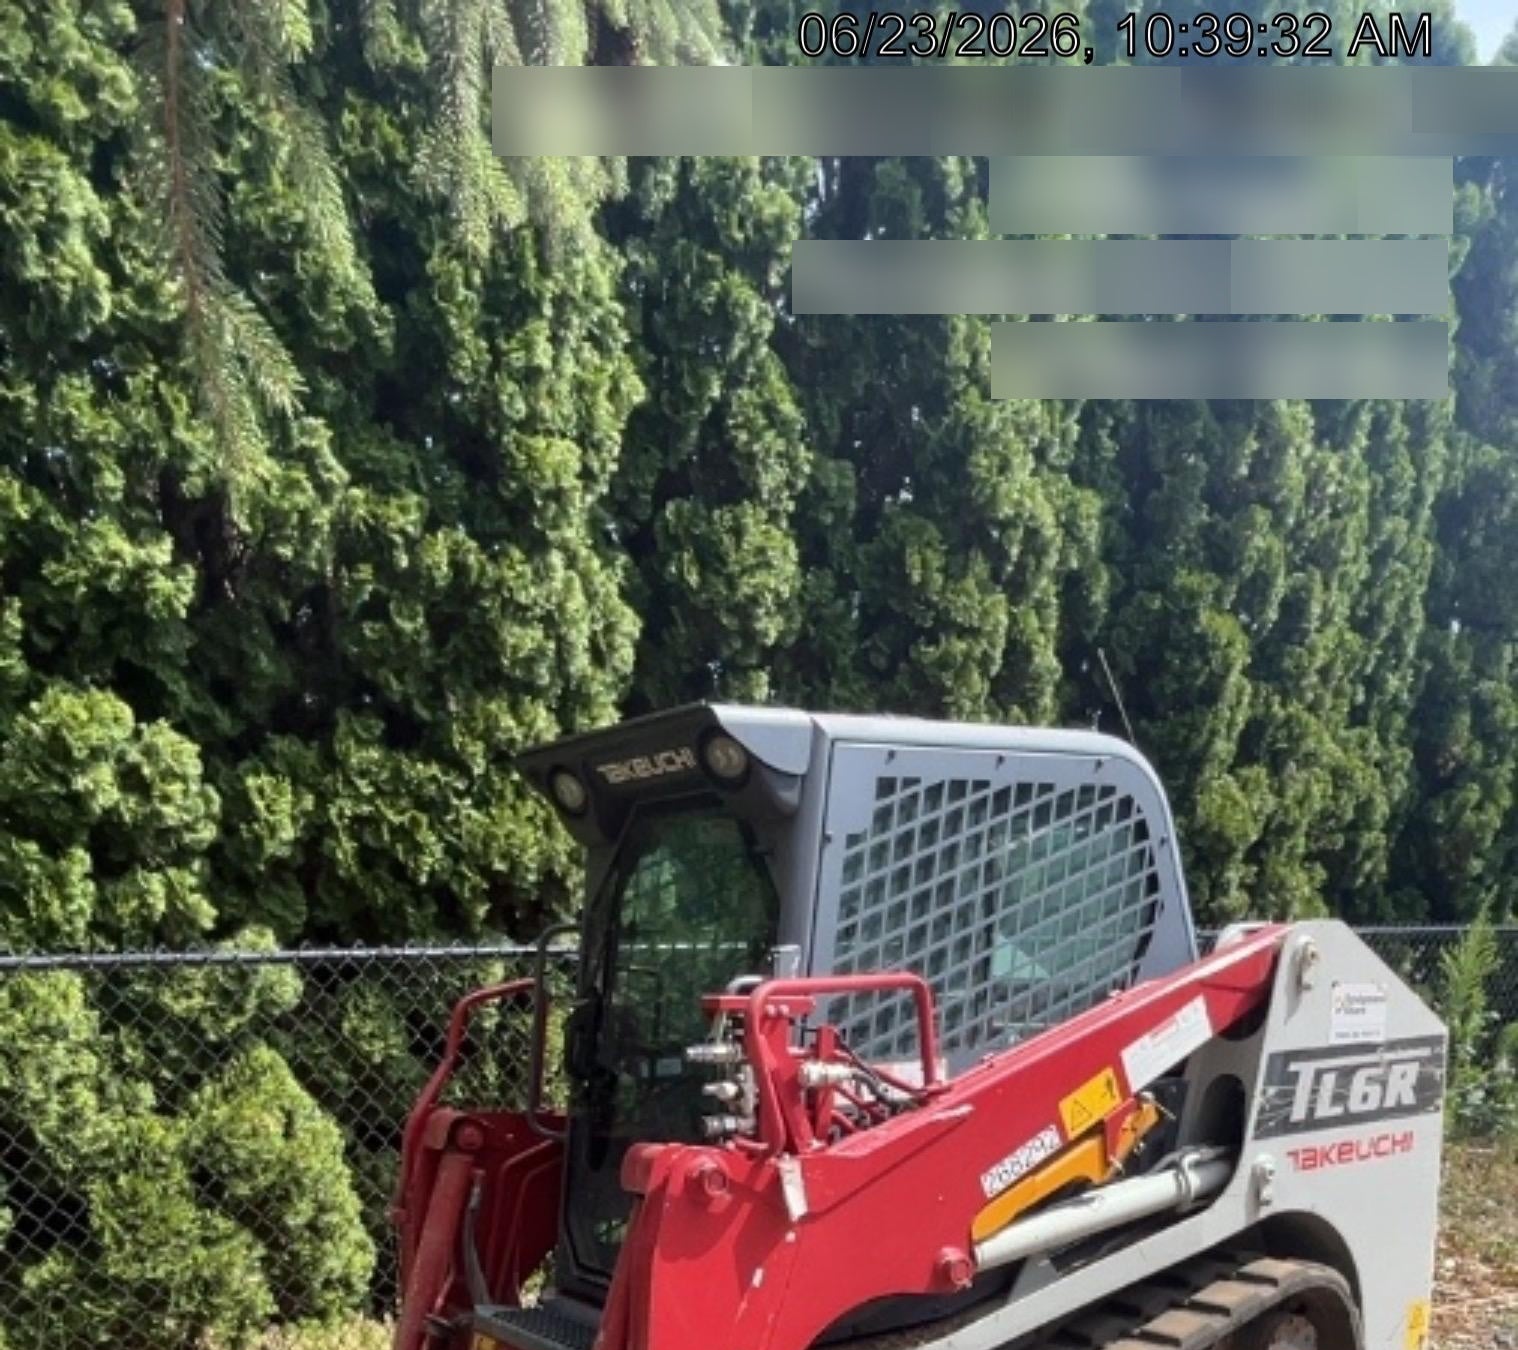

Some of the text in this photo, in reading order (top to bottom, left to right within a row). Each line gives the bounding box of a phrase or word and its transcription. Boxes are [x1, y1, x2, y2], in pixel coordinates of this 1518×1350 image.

[596, 747, 697, 784] TAKEUCHI
[1286, 1055, 1424, 1123] TL6R
[1286, 1130, 1415, 1171] TAKEUCHI
